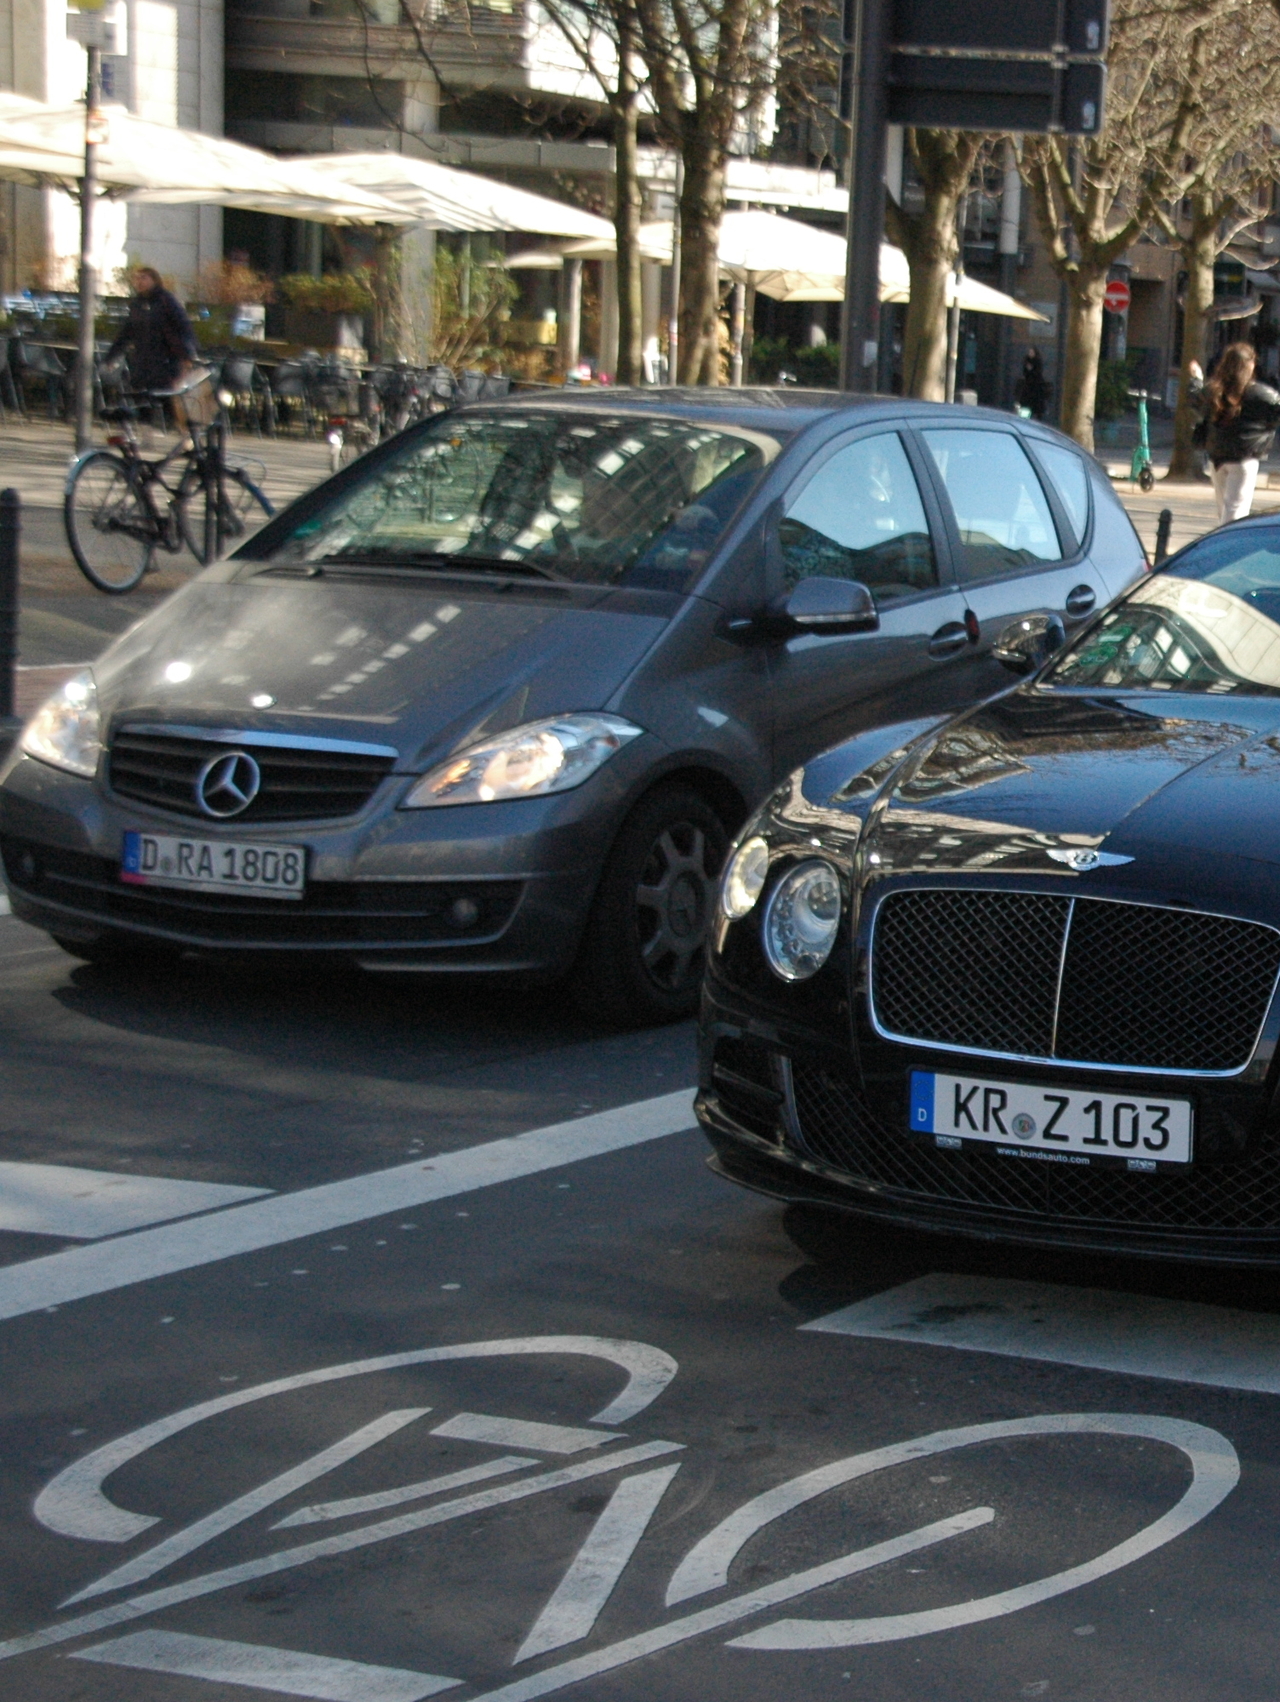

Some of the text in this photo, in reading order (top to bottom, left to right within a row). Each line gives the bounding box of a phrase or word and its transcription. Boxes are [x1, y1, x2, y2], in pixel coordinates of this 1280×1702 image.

[142, 838, 299, 885] D RA 1808
[954, 1083, 1009, 1135] KR
[997, 1147, 1090, 1165] www.bundsauto.com
